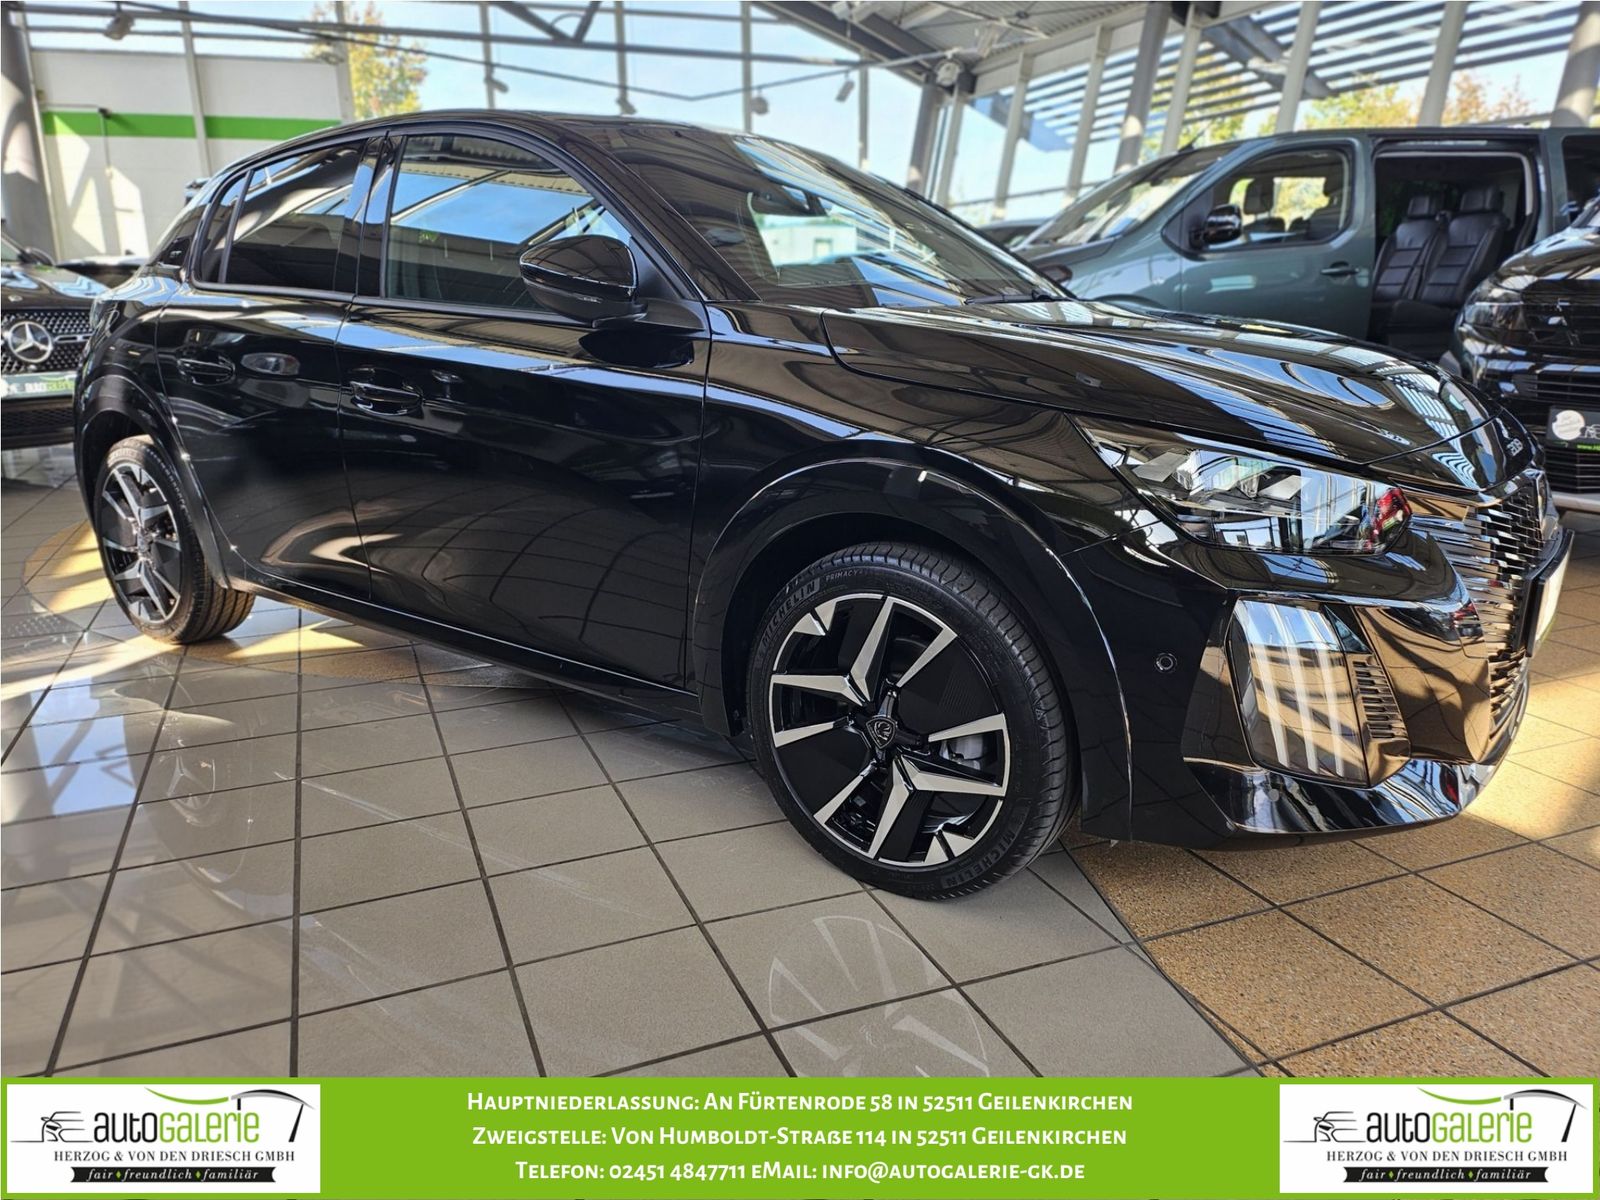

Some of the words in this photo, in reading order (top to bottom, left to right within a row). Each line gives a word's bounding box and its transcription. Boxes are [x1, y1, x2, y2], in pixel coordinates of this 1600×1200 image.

[825, 569, 858, 582] PRIMACY
[761, 580, 817, 648] MICHELIN
[945, 831, 1016, 888] MICHELIN
